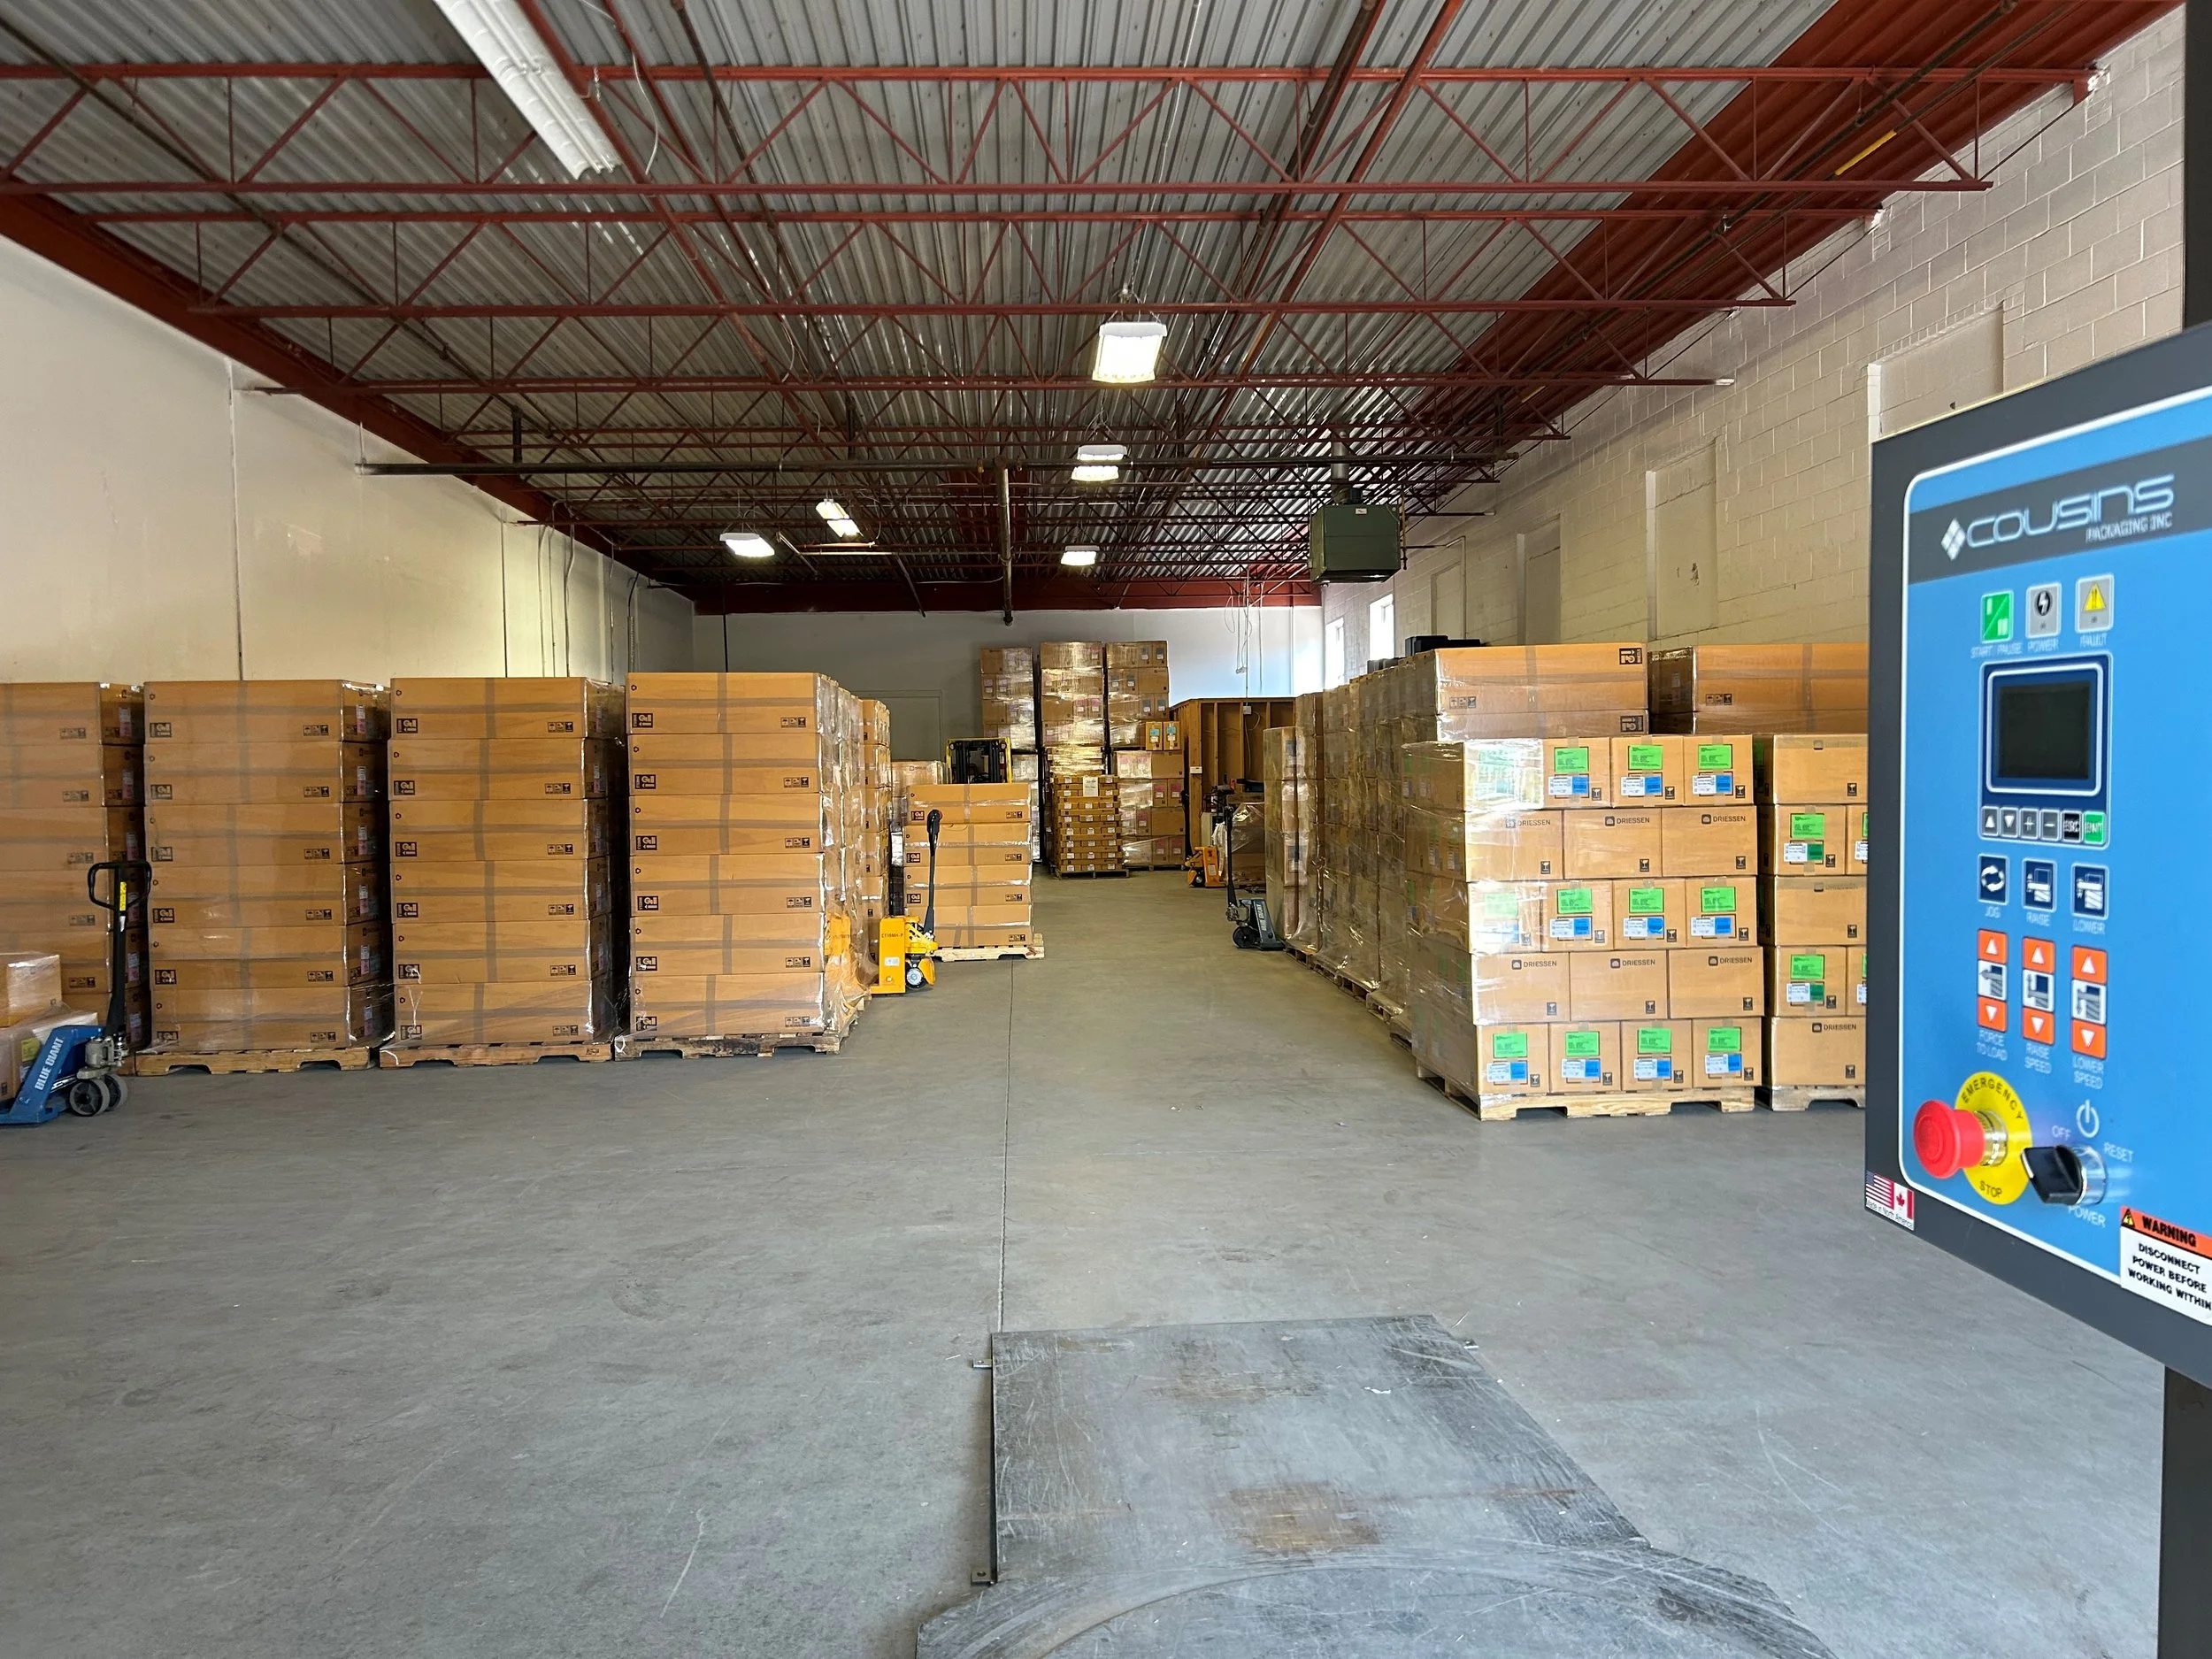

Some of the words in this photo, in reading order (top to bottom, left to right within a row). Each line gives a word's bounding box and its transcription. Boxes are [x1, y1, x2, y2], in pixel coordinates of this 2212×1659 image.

[1967, 473, 2175, 548] COUSINS
[2085, 517, 2148, 543] PACKAGING
[2151, 512, 2173, 531] INC
[2027, 639, 2059, 653] POWER
[1985, 906, 2001, 918] JOG
[2026, 912, 2051, 926] RAISE
[2072, 919, 2106, 934] LOWER
[1978, 1030, 2005, 1047] FORCE
[45, 1037, 64, 1066] GIANT
[1987, 1046, 2008, 1062] LOAD
[2025, 1042, 2050, 1060] RAISE
[2024, 1057, 2052, 1074] SPEED
[2072, 1056, 2104, 1074] LOWER
[2073, 1071, 2104, 1090] SPEED
[1961, 1076, 2024, 1120] EMERGENCY
[2051, 1125, 2072, 1141] OFF
[2103, 1141, 2134, 1163] RESET
[1979, 1180, 2002, 1198] STOP
[2068, 1205, 2106, 1228] POWER
[2141, 1215, 2197, 1248] WARNING
[2138, 1242, 2200, 1274] DISCONNECT
[2131, 1255, 2166, 1276] POWER
[2168, 1270, 2208, 1294] BEFORE
[2127, 1267, 2173, 1294] WORKING
[2176, 1287, 2212, 1311] WITHIN
